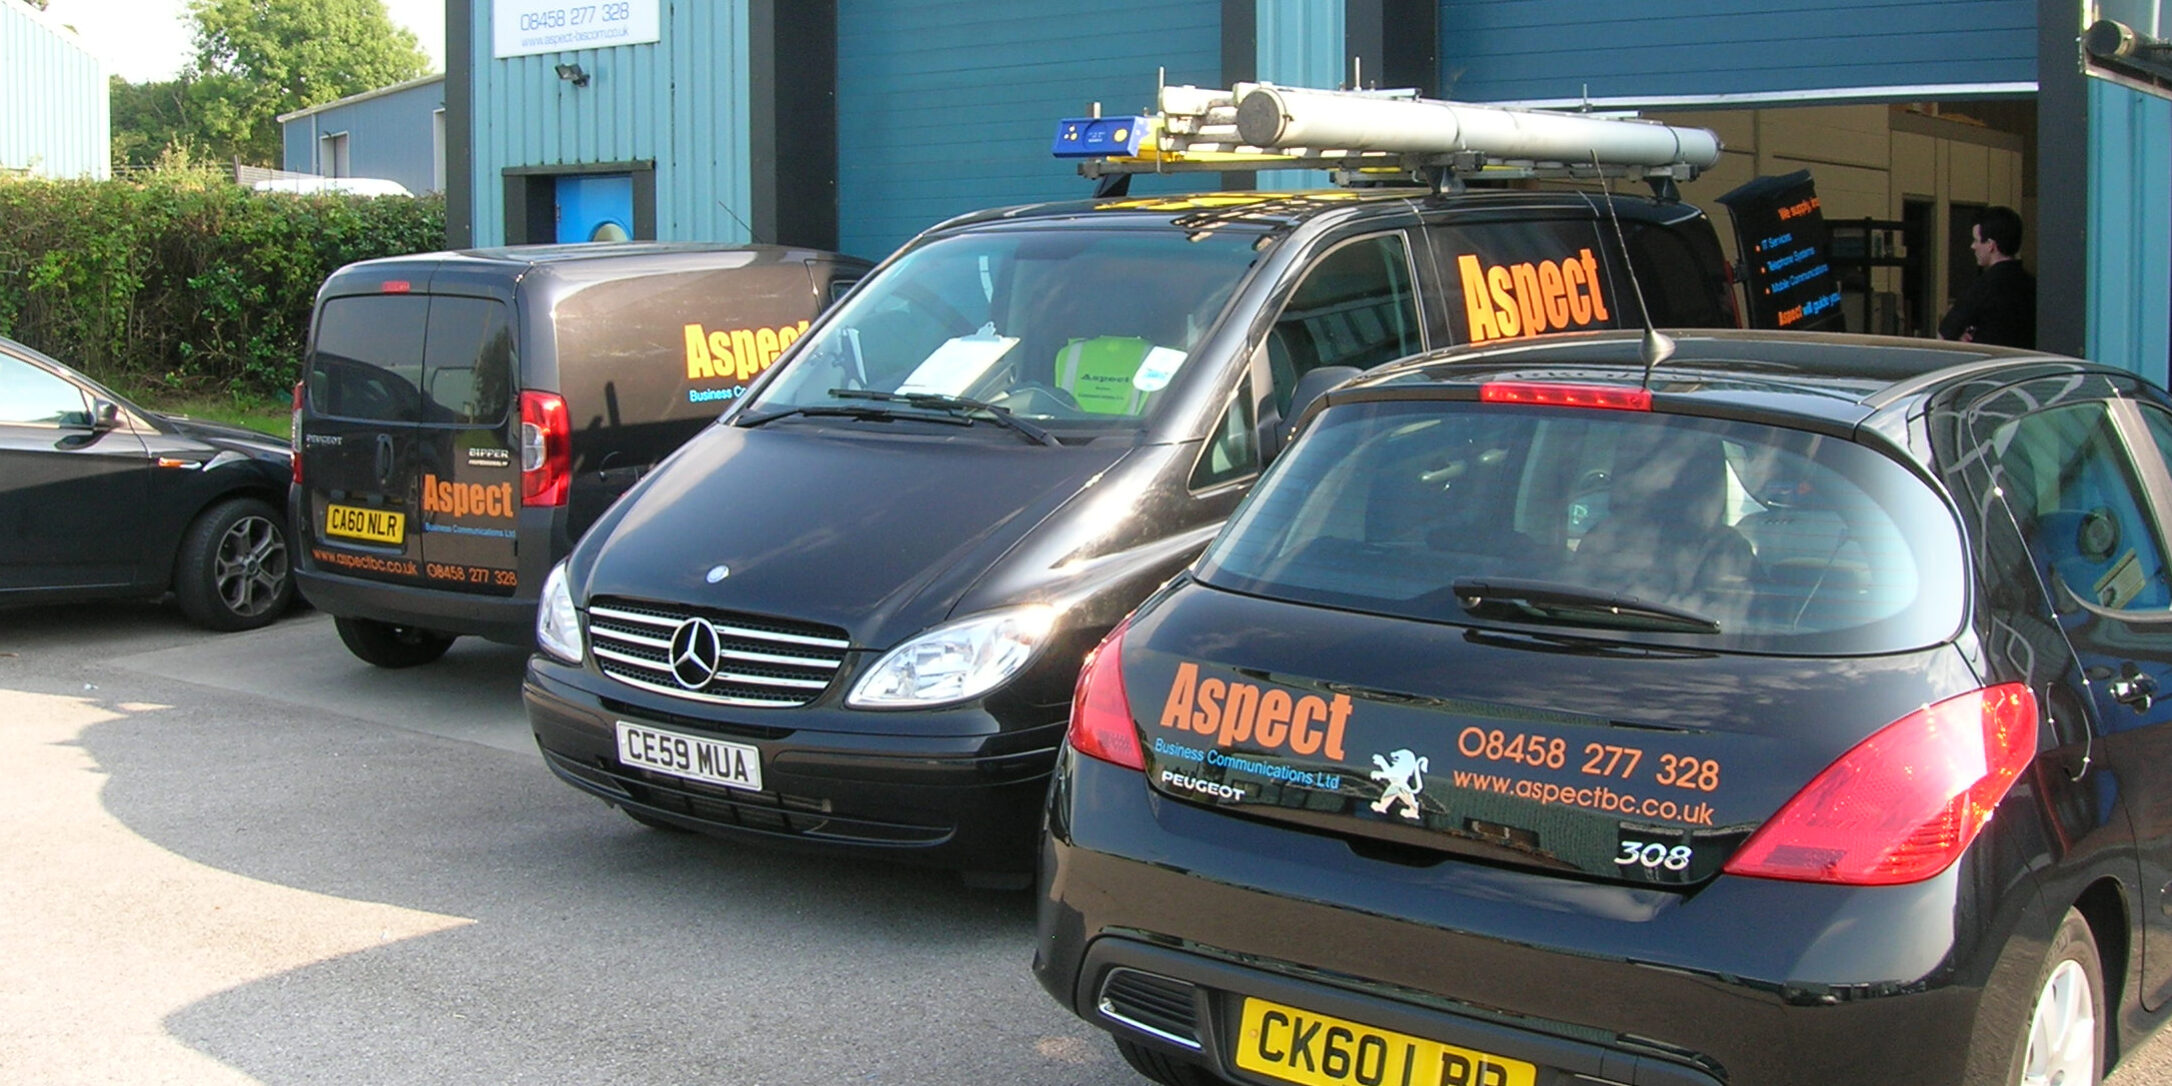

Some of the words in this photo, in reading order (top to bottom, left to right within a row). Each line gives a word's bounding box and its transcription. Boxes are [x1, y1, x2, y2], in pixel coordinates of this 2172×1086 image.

[521, 9, 565, 31] 08458
[570, 5, 596, 25] 277
[602, 1, 629, 21] 328
[1458, 248, 1609, 342] Aspect
[1081, 373, 1129, 383] Aspect
[689, 388, 733, 402] Business
[469, 447, 509, 459] BIPPER
[423, 474, 514, 517] Aspect
[332, 508, 364, 532] CA60
[367, 512, 397, 537] NLR
[312, 549, 418, 575] www.aspectbc.co.uk
[426, 563, 465, 581] 08458
[469, 567, 489, 582] 277
[494, 570, 518, 586] 328
[1160, 661, 1353, 761] Aspect
[627, 728, 690, 771] CE59
[696, 741, 749, 782] MUA
[1154, 738, 1204, 762] Business
[1206, 750, 1314, 786] Communications
[1315, 772, 1340, 790] Ltd
[1457, 726, 1566, 769] 08458
[1581, 743, 1643, 779] 277
[1655, 753, 1720, 793] 328
[1161, 771, 1245, 801] PEUGEOT
[1453, 770, 1715, 826] www.aspectbc.co.uk
[1614, 840, 1692, 871] 308
[1258, 1010, 1388, 1086] CK60
